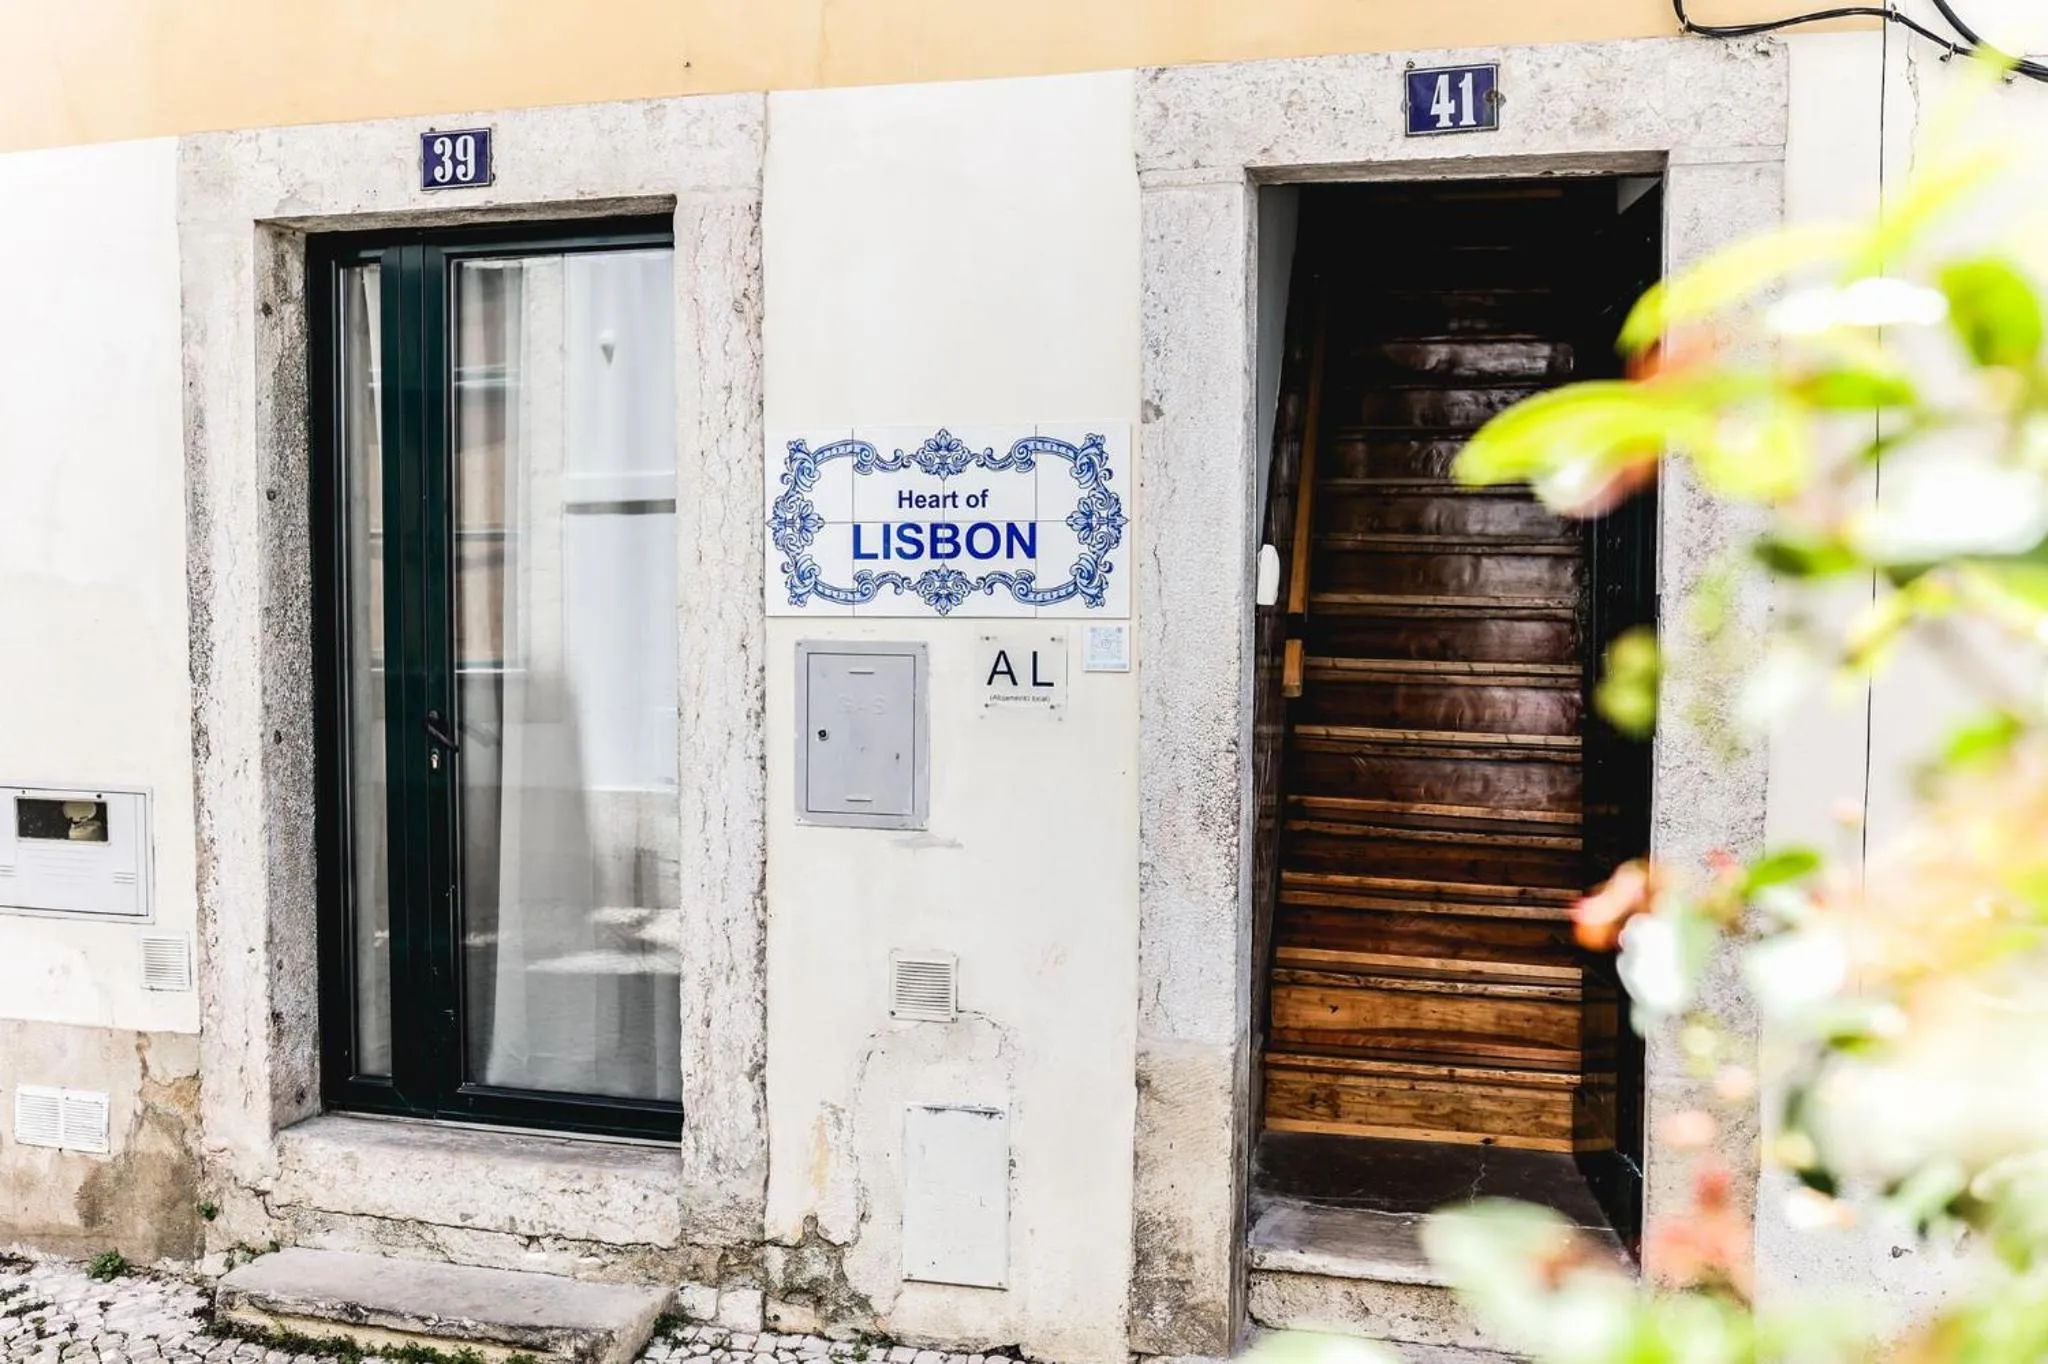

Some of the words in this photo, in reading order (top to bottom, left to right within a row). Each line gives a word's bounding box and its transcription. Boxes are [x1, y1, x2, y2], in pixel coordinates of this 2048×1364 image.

[1430, 71, 1477, 128] 41
[433, 135, 476, 183] 39
[897, 489, 959, 509] Heart
[965, 489, 989, 509] of
[852, 522, 1037, 560] LISBON
